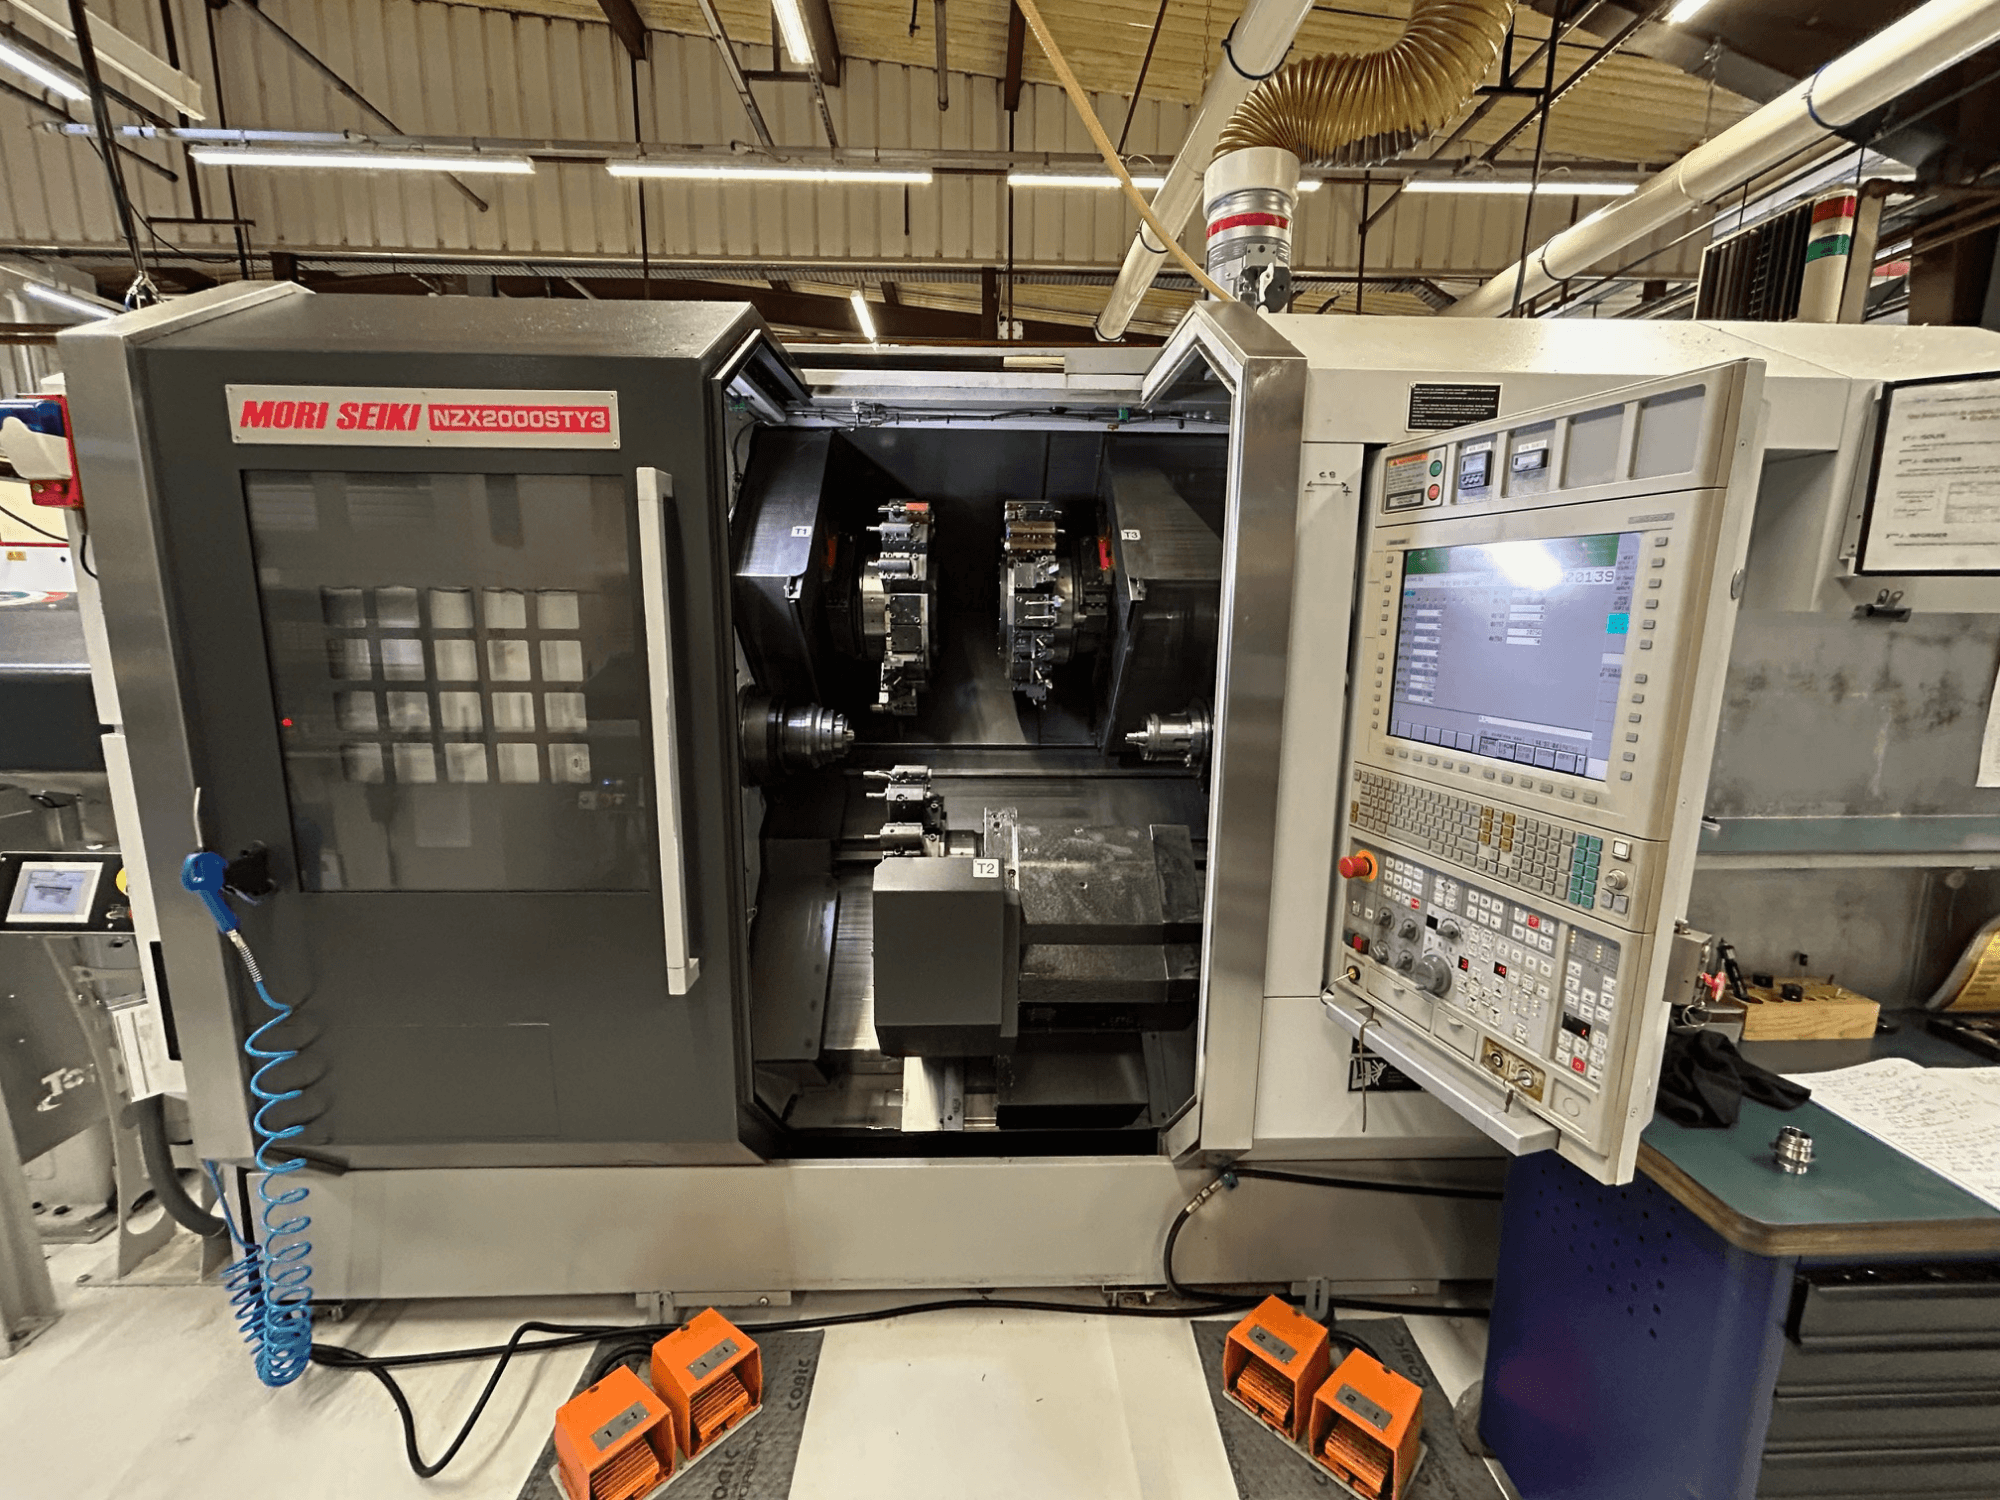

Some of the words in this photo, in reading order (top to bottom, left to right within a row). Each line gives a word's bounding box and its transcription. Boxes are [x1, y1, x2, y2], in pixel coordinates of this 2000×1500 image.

[239, 400, 329, 429] MORI
[336, 402, 422, 431] SEIKI
[433, 408, 607, 429] NZX2000STY3
[977, 863, 995, 874] T2
